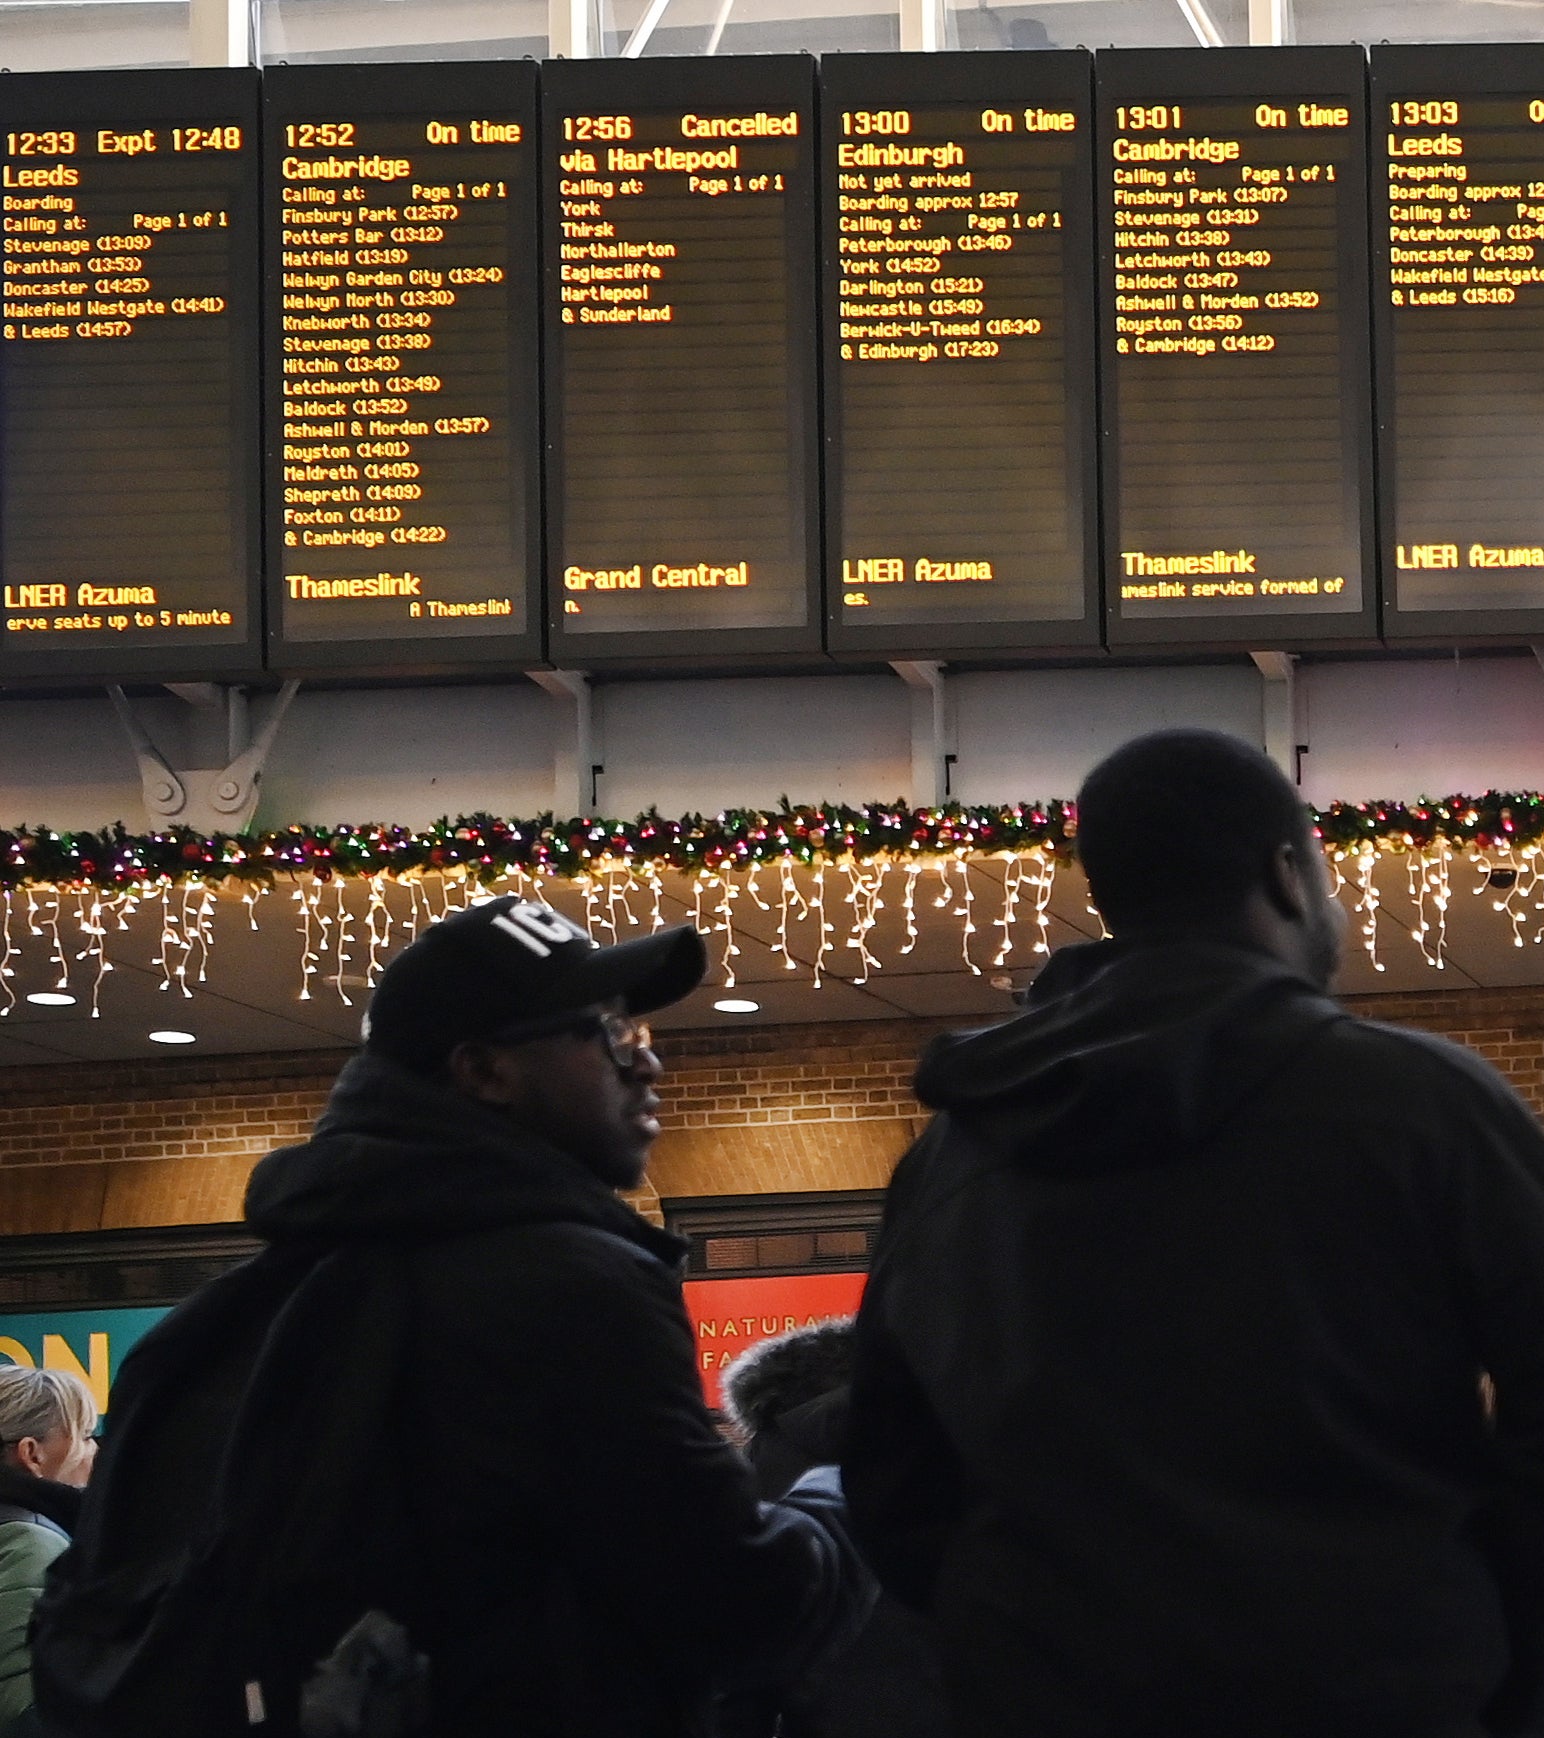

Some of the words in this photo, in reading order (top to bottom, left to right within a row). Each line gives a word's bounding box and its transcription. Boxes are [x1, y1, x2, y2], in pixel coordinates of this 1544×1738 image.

[843, 111, 911, 136] 13:00
[982, 109, 1013, 133] On
[1024, 109, 1075, 132] time
[1117, 105, 1181, 130] 13:01
[1256, 104, 1287, 128] On
[1298, 104, 1349, 127] time
[1391, 101, 1459, 126] 13:03
[287, 123, 355, 148] 12:52
[427, 121, 459, 145] On
[469, 121, 521, 143] time
[565, 115, 632, 141] 12:56
[682, 112, 798, 138] Cancelled
[8, 131, 76, 156] 12:33
[98, 129, 157, 156] Expt
[174, 127, 241, 152] 12:48
[1114, 138, 1240, 164] Cambridge
[1389, 133, 1463, 157] Leeds
[561, 149, 597, 173] via
[608, 145, 737, 174] Hartlepool
[839, 142, 964, 169] Edinburgh
[4, 164, 79, 188] Leeds
[283, 155, 411, 181] Cambridge
[1390, 163, 1467, 182] Preparing
[4, 195, 74, 213] Boarding
[1116, 189, 1184, 208] Finsbury
[1191, 188, 1228, 204] Park
[1235, 186, 1288, 203] (13:07)
[563, 202, 601, 217] York
[562, 221, 615, 238] Thirsk
[284, 250, 350, 267] Hatfield
[356, 248, 409, 265] (13:19)
[562, 242, 676, 260] Northallerton
[5, 259, 81, 275] Grantham
[89, 256, 142, 273] (13:53)
[563, 263, 662, 284] Eaglescliffe
[563, 285, 649, 304] Hartlepool
[5, 302, 82, 318] Wakefield
[87, 300, 166, 319] Westgate
[172, 297, 225, 314] (14:41)
[563, 307, 575, 324] &
[580, 306, 672, 323] Sunderland
[842, 320, 981, 339] Berwick-U-Tweed
[988, 319, 1042, 335] (16:34)
[1124, 550, 1256, 576] Thameslink
[1396, 543, 1459, 570] LNER
[568, 564, 642, 592] Grand
[651, 561, 750, 589] Central
[845, 558, 905, 584] LNER
[914, 557, 993, 582] Azuma
[6, 583, 67, 609] LNER
[78, 583, 157, 607] Azuma
[287, 572, 422, 599] Thameslink
[699, 1314, 849, 1338] NATURA
